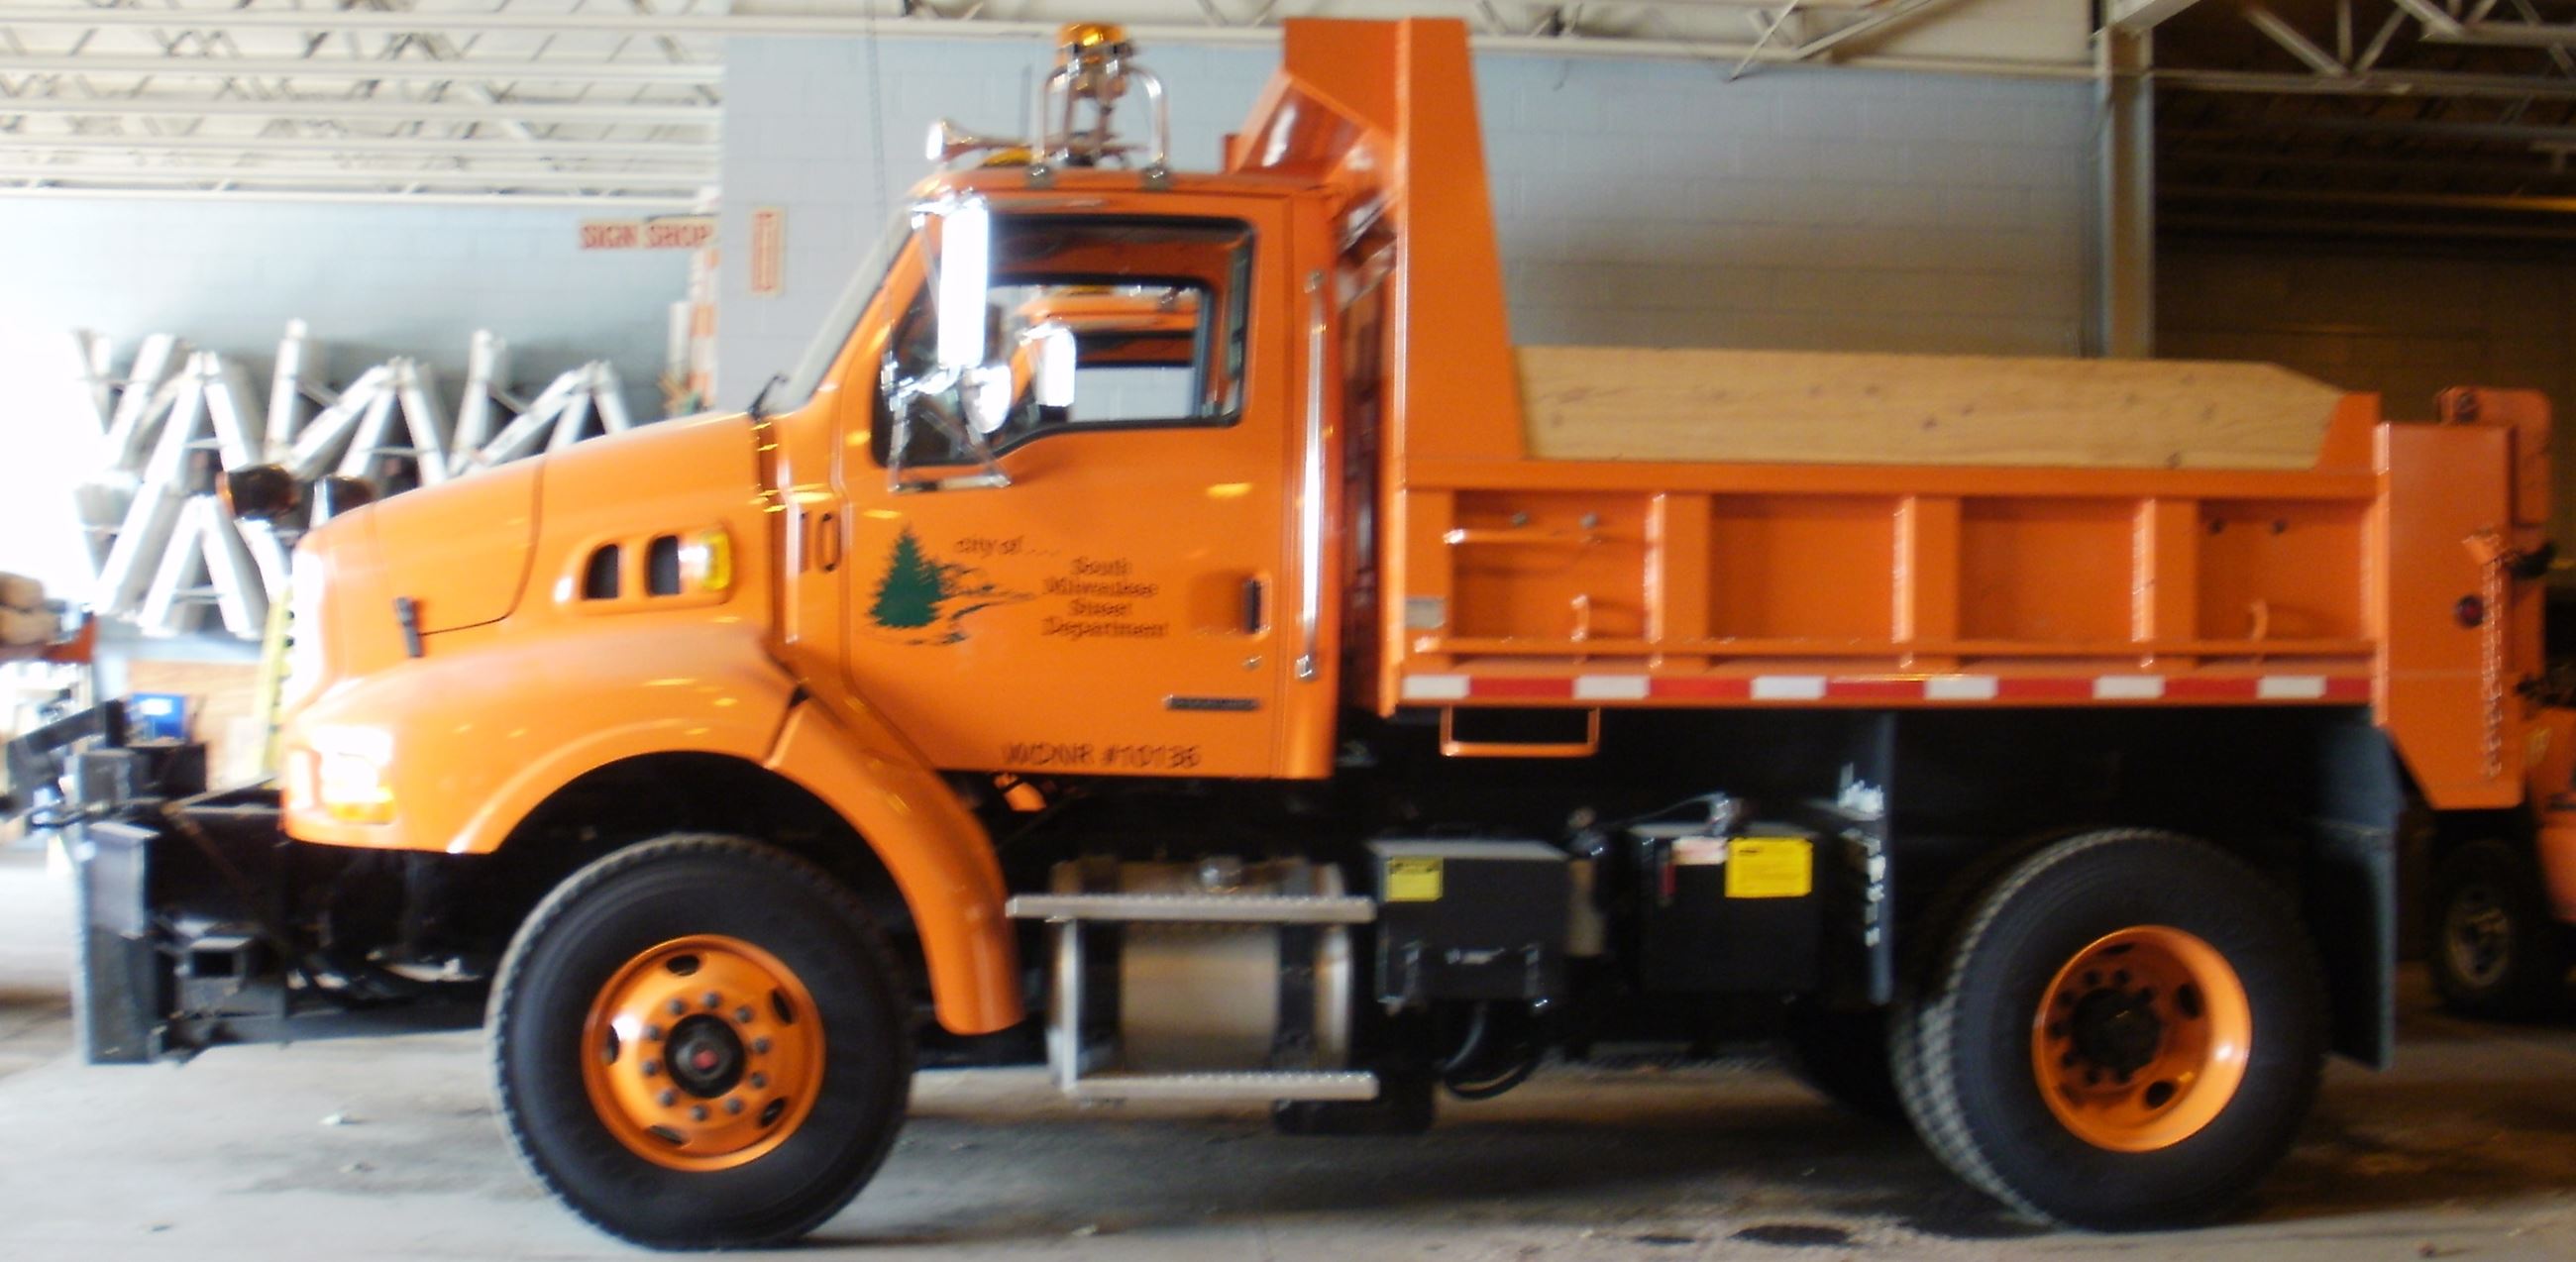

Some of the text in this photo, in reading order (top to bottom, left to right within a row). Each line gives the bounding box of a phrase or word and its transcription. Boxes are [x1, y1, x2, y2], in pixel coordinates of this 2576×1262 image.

[580, 224, 712, 249] SIGN SHOP
[1071, 556, 1131, 576] South
[1042, 577, 1159, 598] Milwaukee
[1069, 597, 1131, 616] Street
[1041, 616, 1169, 640] Department
